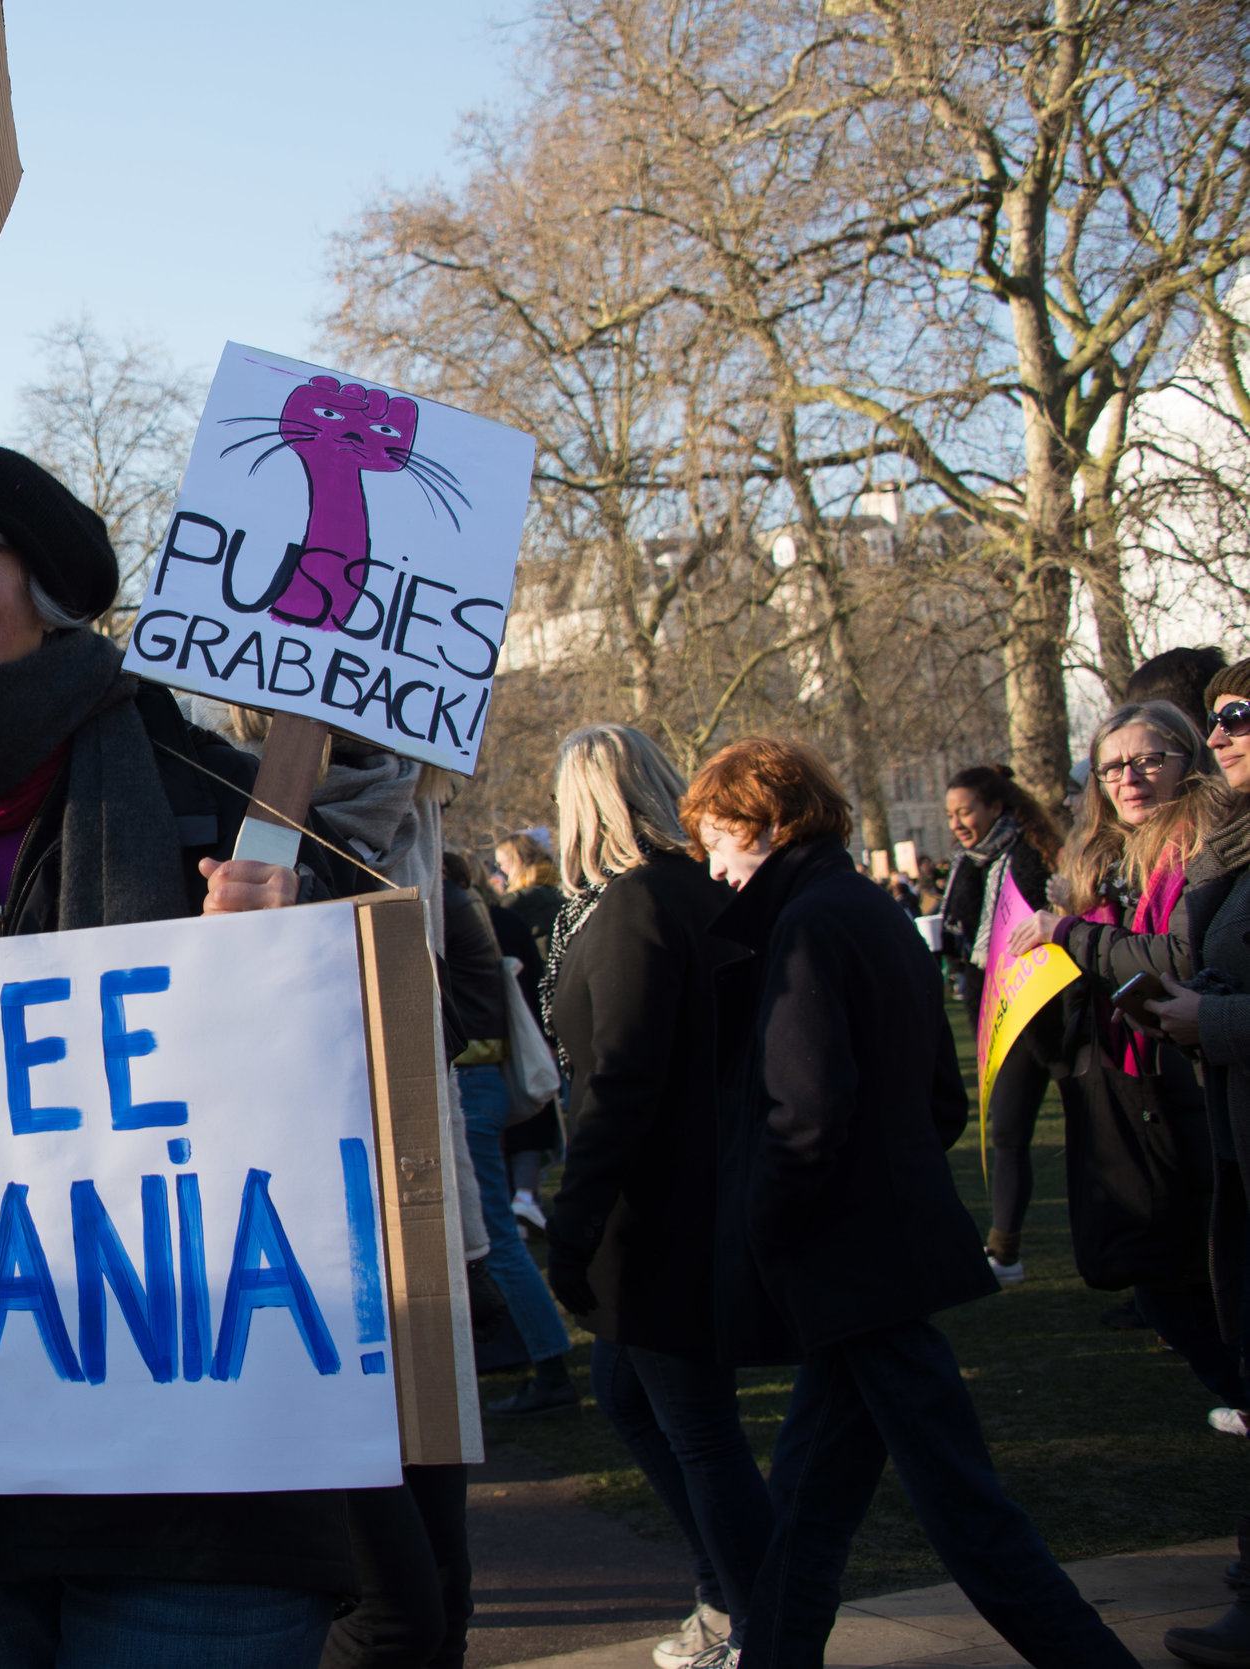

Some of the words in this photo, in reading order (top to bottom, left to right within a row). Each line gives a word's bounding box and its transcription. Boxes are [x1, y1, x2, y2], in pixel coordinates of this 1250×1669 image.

[133, 609, 316, 697] GRAB
[320, 648, 489, 756] BACK!
[1004, 945, 1050, 1006] hate
